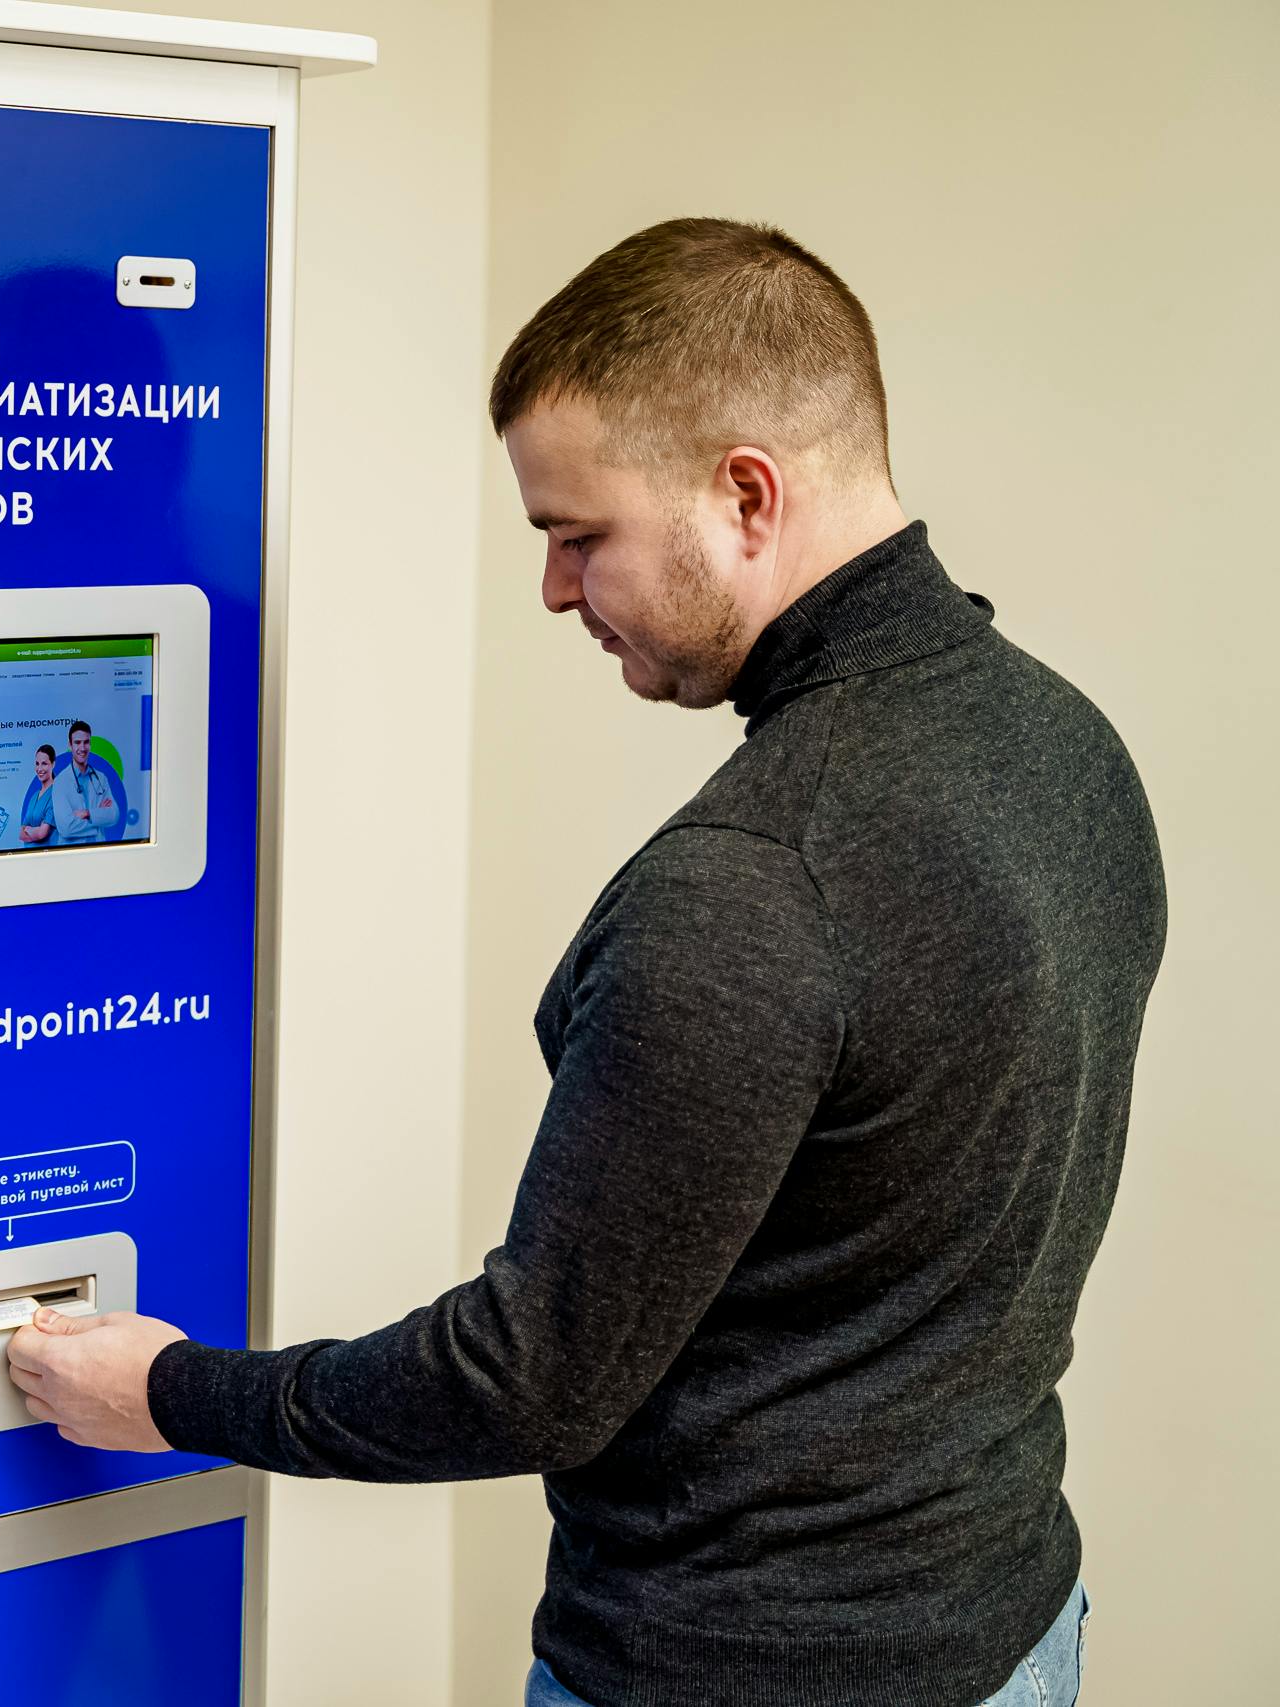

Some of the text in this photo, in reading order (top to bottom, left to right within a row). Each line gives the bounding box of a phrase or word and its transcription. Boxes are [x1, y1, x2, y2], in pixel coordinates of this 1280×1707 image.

[13, 1165, 81, 1185] этикетку.
[31, 1180, 89, 1202] путевой
[93, 1177, 125, 1191] лист
